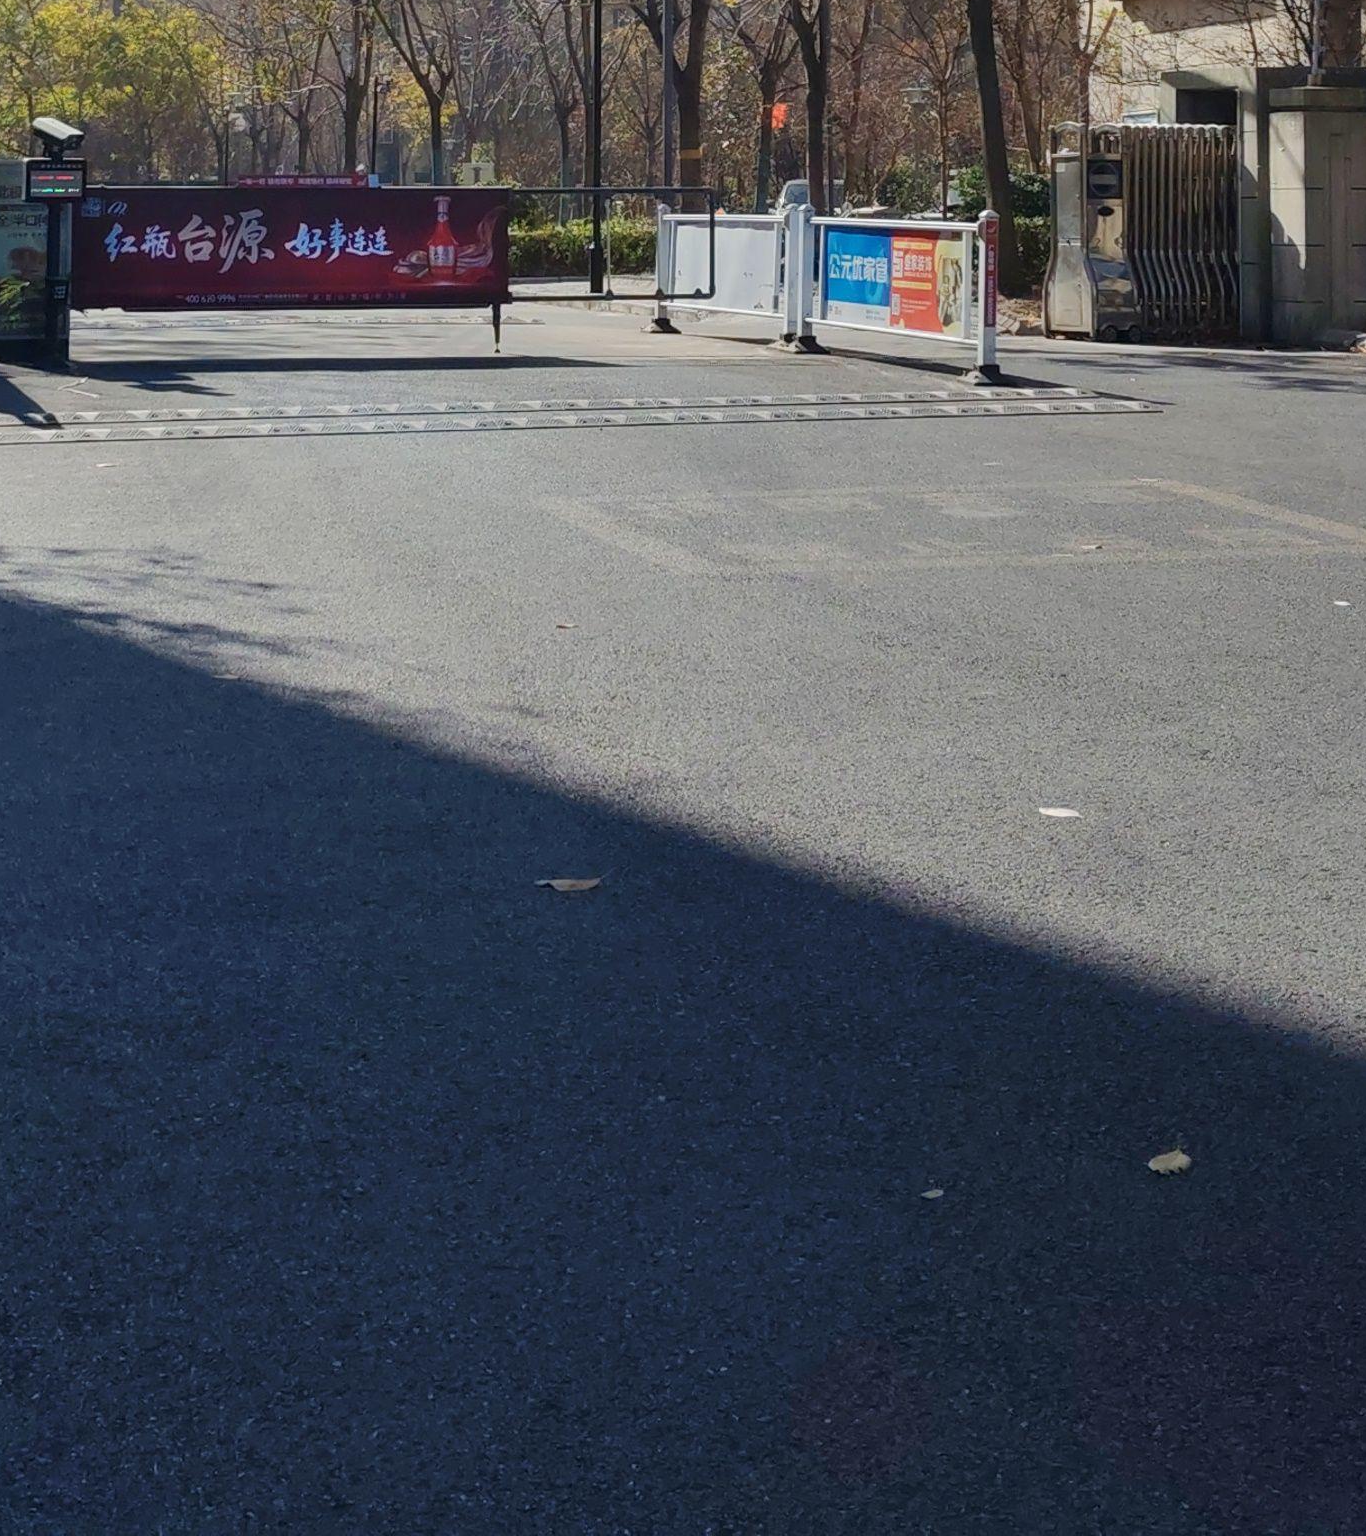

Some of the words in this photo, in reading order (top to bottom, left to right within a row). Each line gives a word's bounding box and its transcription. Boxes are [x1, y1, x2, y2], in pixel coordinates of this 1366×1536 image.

[103, 208, 275, 275] 红瓶台源
[283, 217, 394, 264] 好事连连
